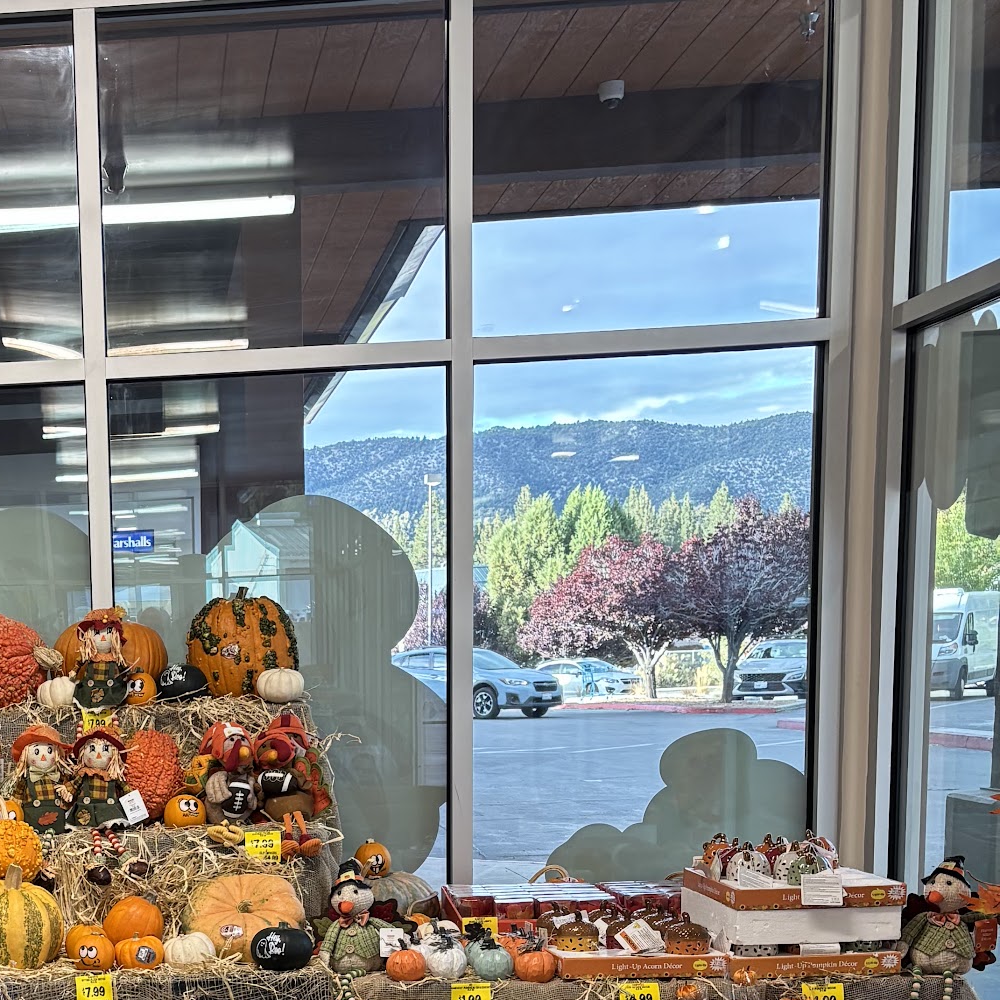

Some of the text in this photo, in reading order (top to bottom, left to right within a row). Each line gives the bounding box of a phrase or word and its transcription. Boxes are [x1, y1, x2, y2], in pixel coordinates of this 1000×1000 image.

[113, 535, 152, 549] arshalls
[611, 963, 642, 972] Light-Up
[663, 962, 683, 970] Décor
[82, 985, 106, 998] $7.99
